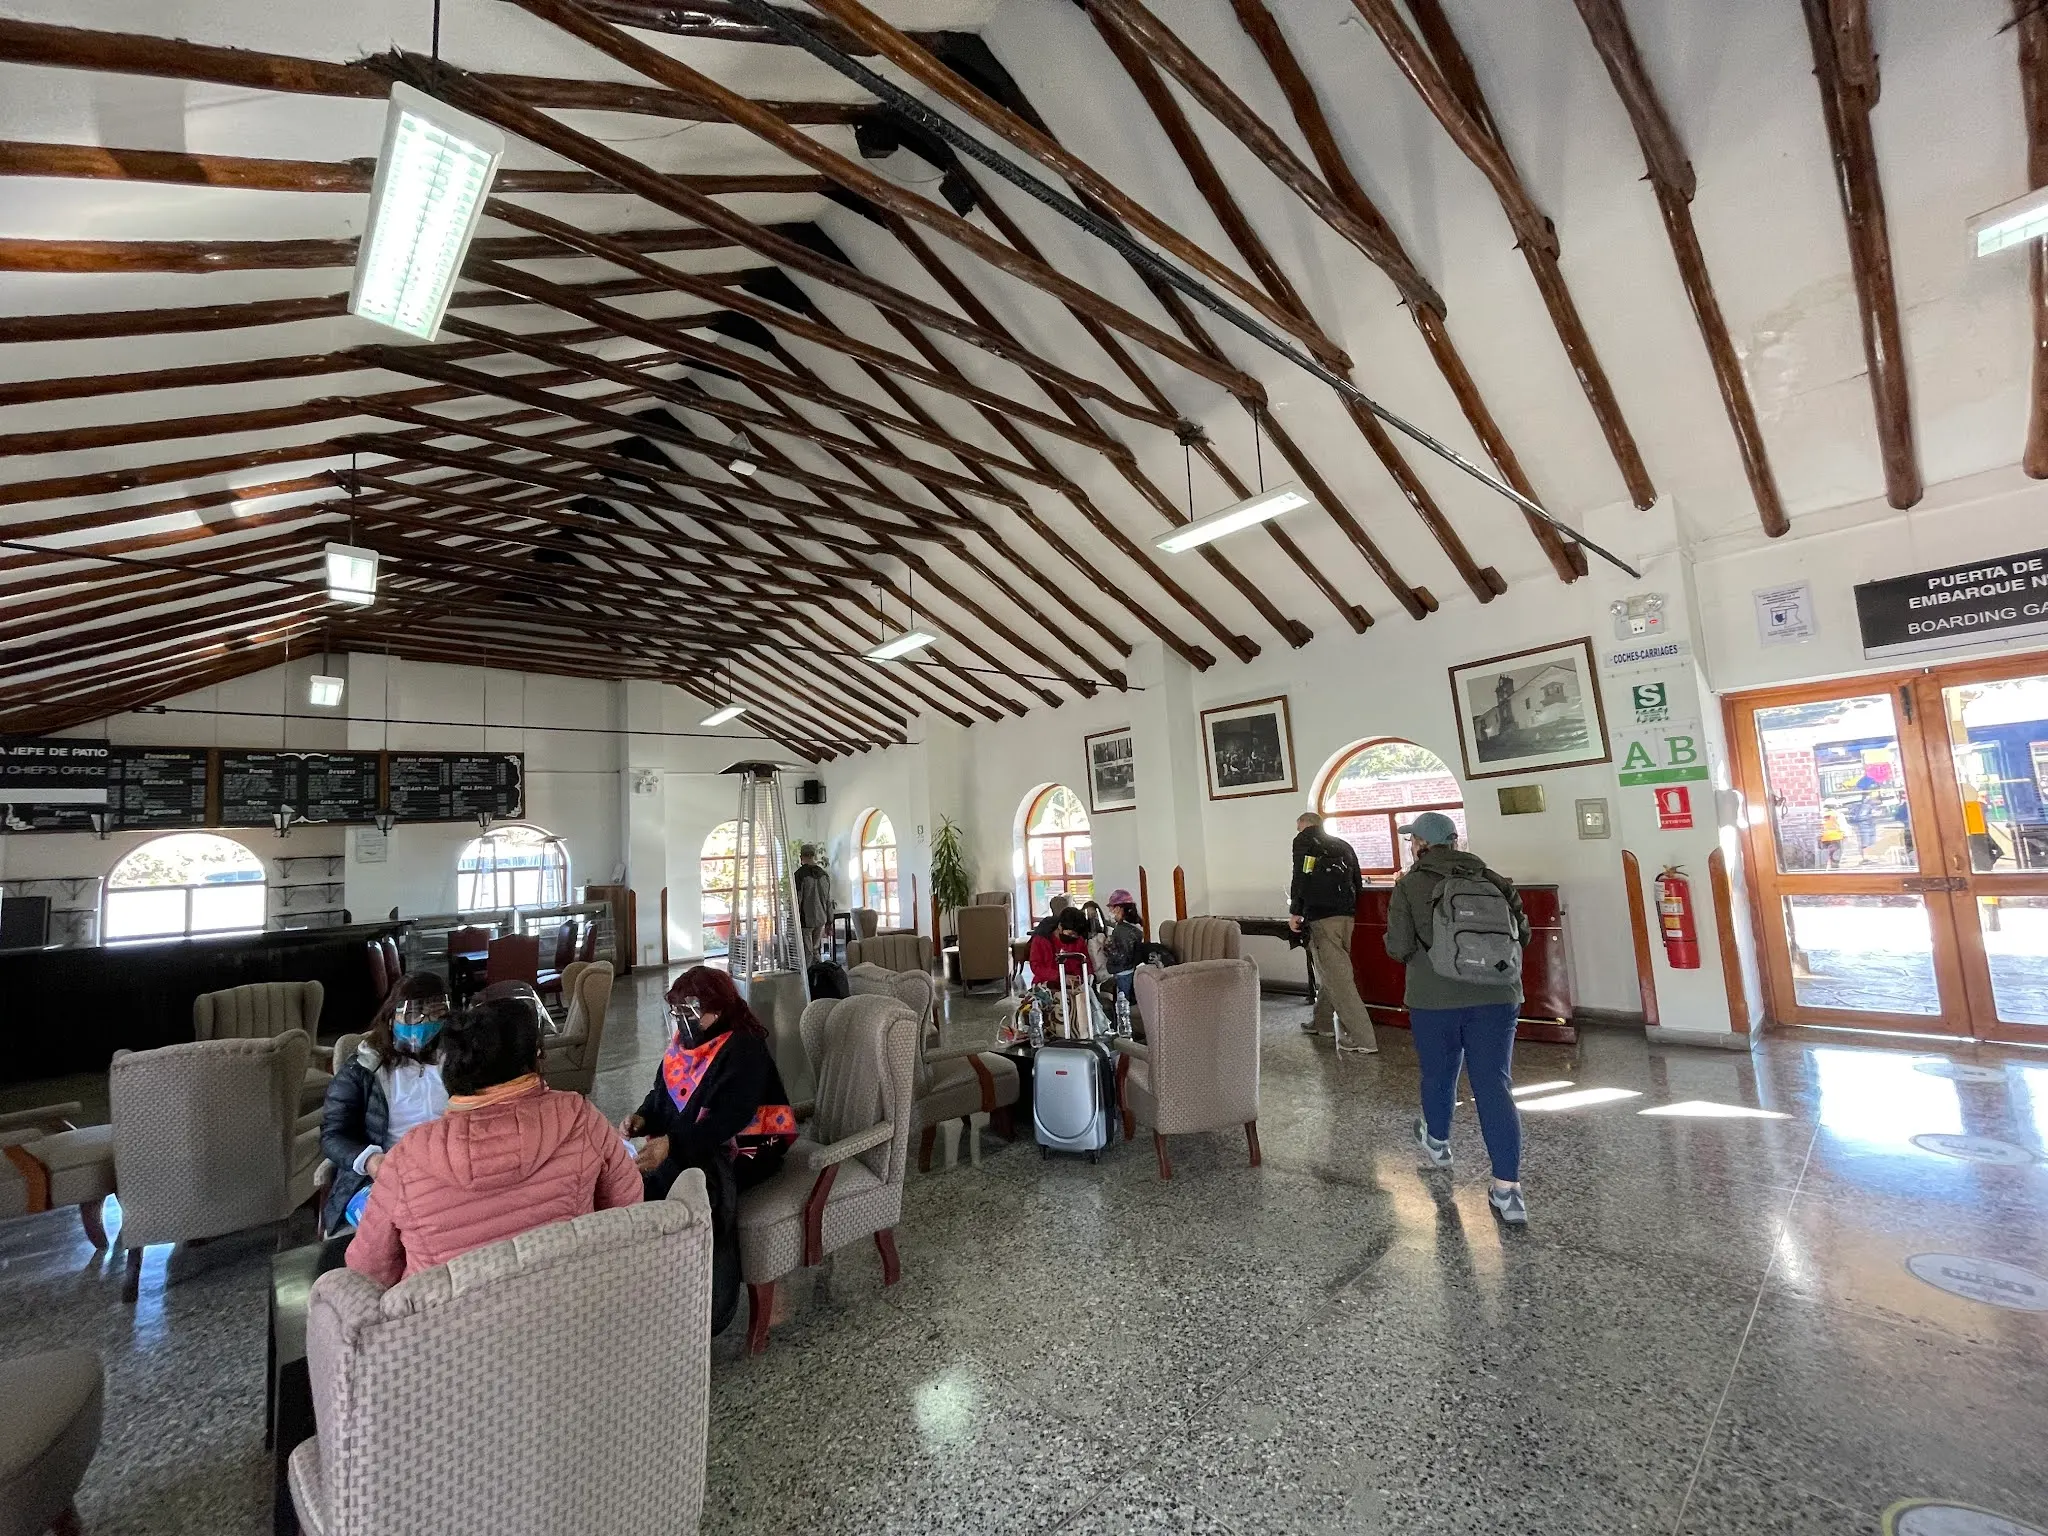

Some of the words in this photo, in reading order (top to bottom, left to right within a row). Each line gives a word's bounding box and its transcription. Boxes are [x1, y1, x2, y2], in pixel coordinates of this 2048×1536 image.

[1928, 566, 2007, 589] PUERTA
[2012, 558, 2043, 574] DE
[1908, 578, 2026, 609] EMBARQUE
[2031, 573, 2048, 588] N
[1907, 607, 2017, 634] BOARDING
[1613, 645, 1678, 664] COCHES-CARRIAGES
[1638, 684, 1661, 707] S
[9, 747, 46, 756] JEFE
[49, 748, 69, 756] DE
[72, 748, 108, 757] PATIO
[1621, 741, 1657, 770] A
[1664, 735, 1697, 766] B
[60, 766, 107, 775] OFFICE
